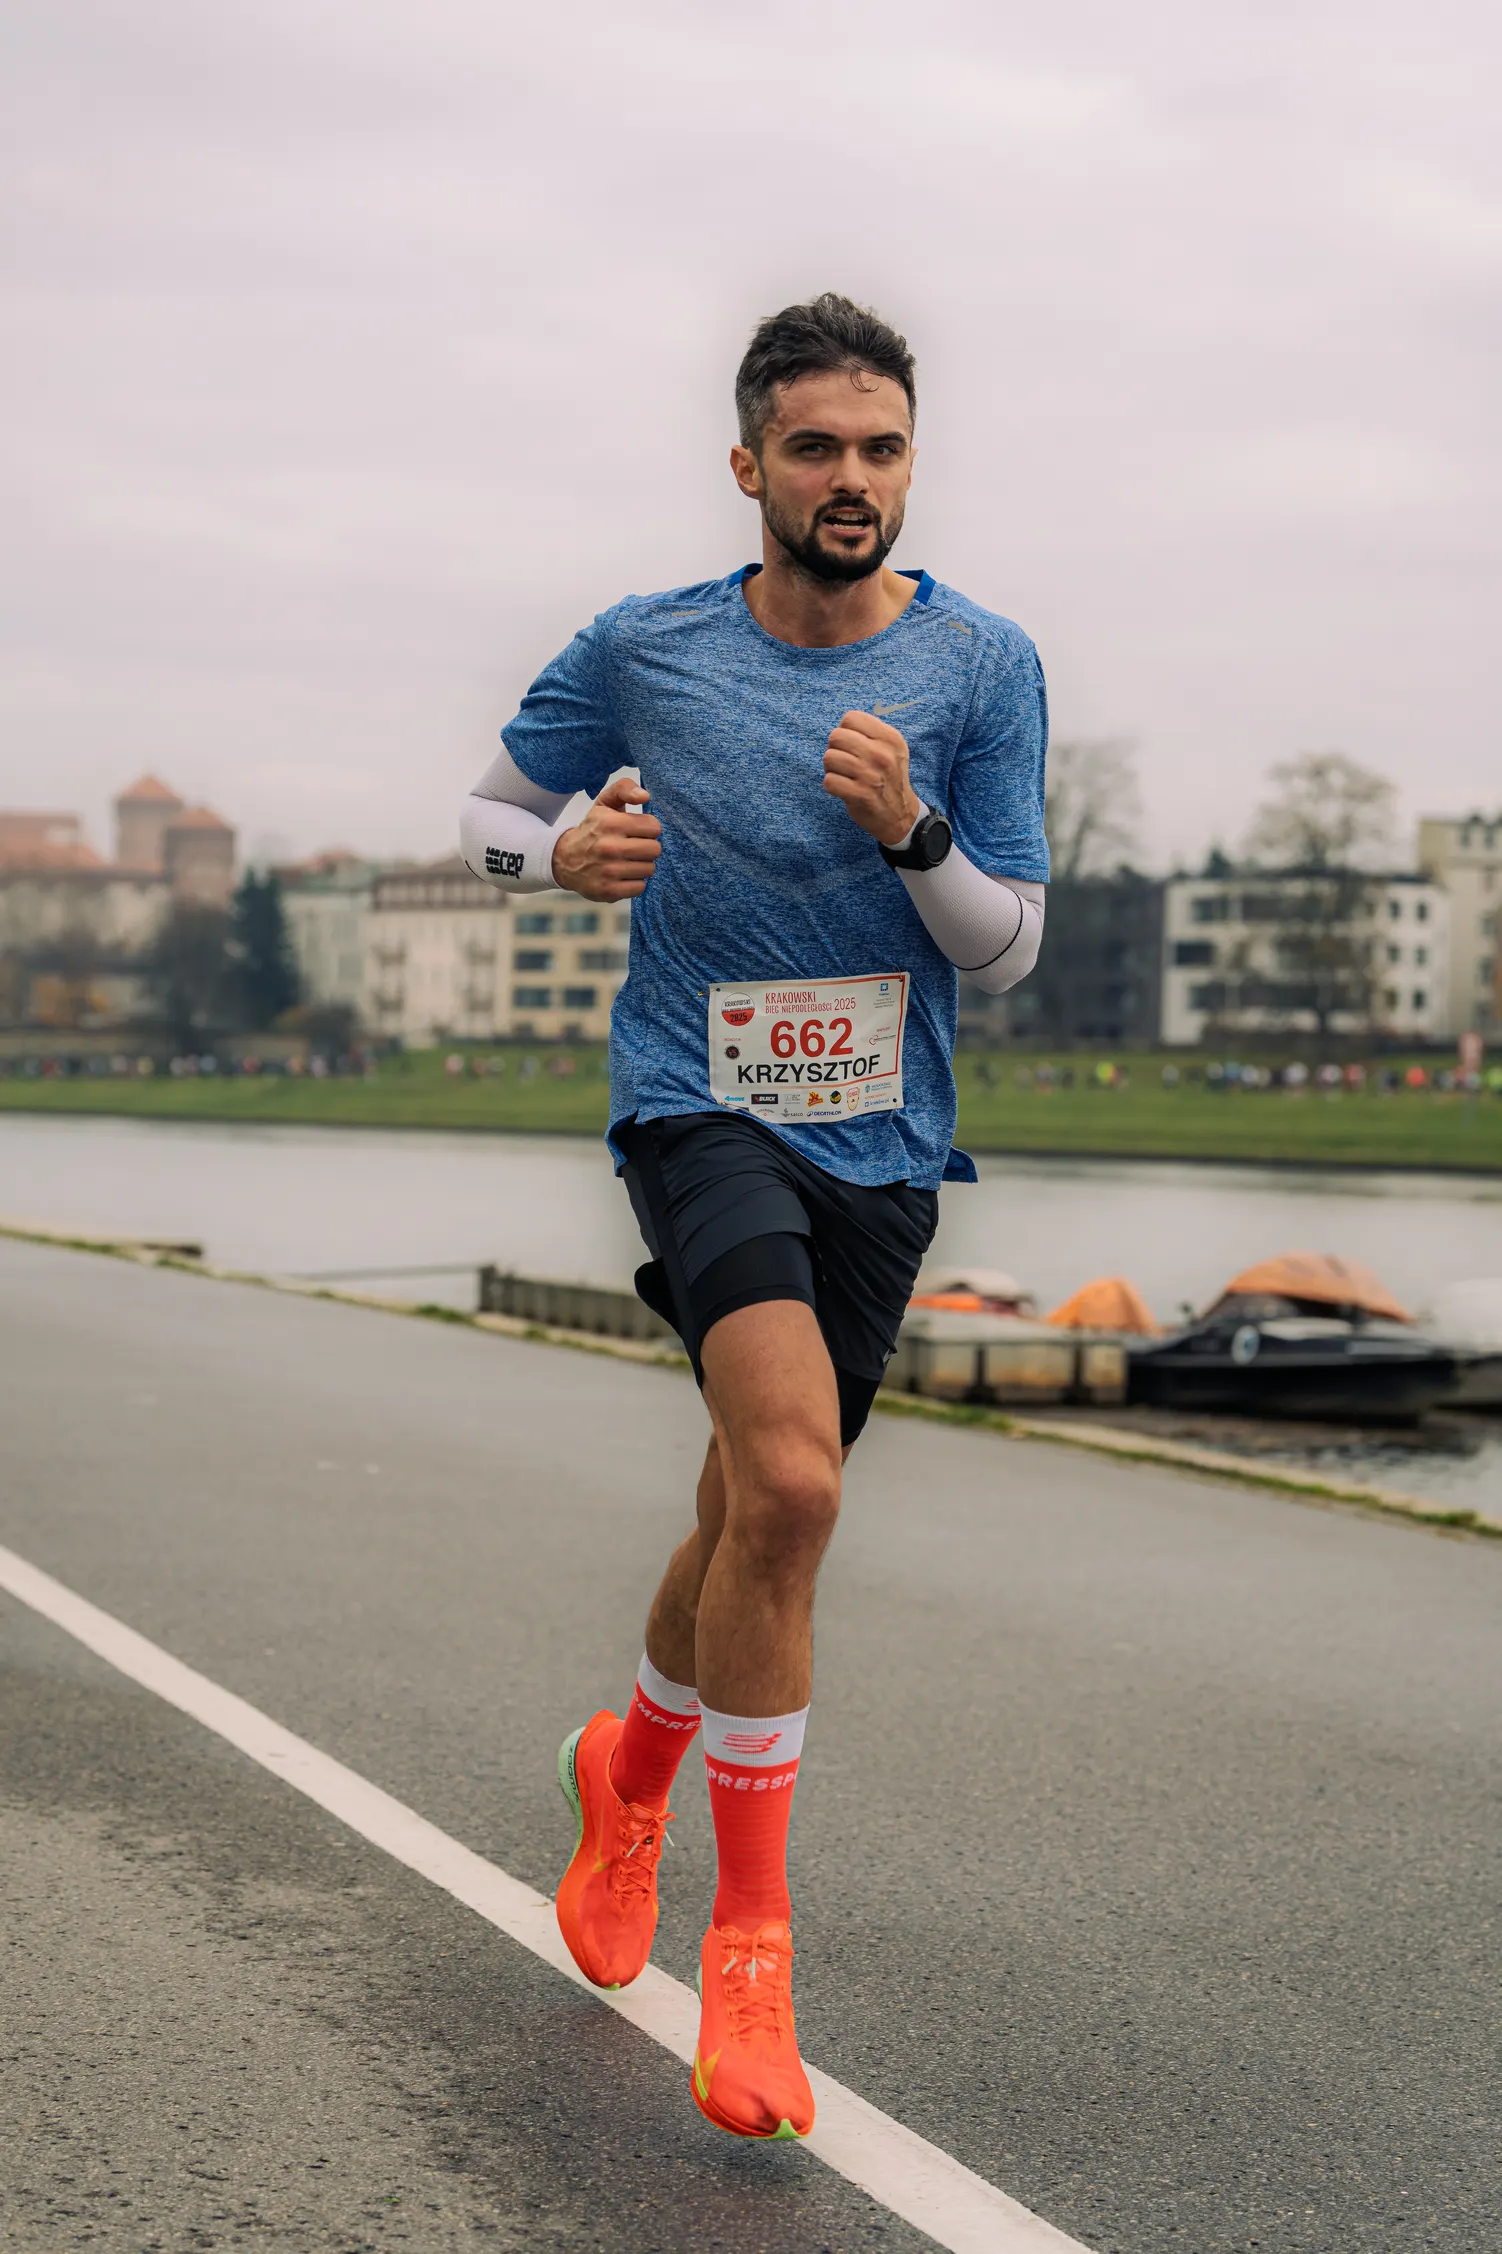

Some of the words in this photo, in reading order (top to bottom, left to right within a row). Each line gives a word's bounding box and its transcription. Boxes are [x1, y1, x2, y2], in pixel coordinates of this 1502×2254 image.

[765, 991, 816, 1004] KRAKOWSKI
[765, 1005, 779, 1014] BIEG
[781, 1002, 832, 1014] NIEPODLEGŁOŚCI
[834, 997, 856, 1011] 2025
[770, 1017, 854, 1058] 662
[737, 1054, 880, 1084] KRZYSZTOF
